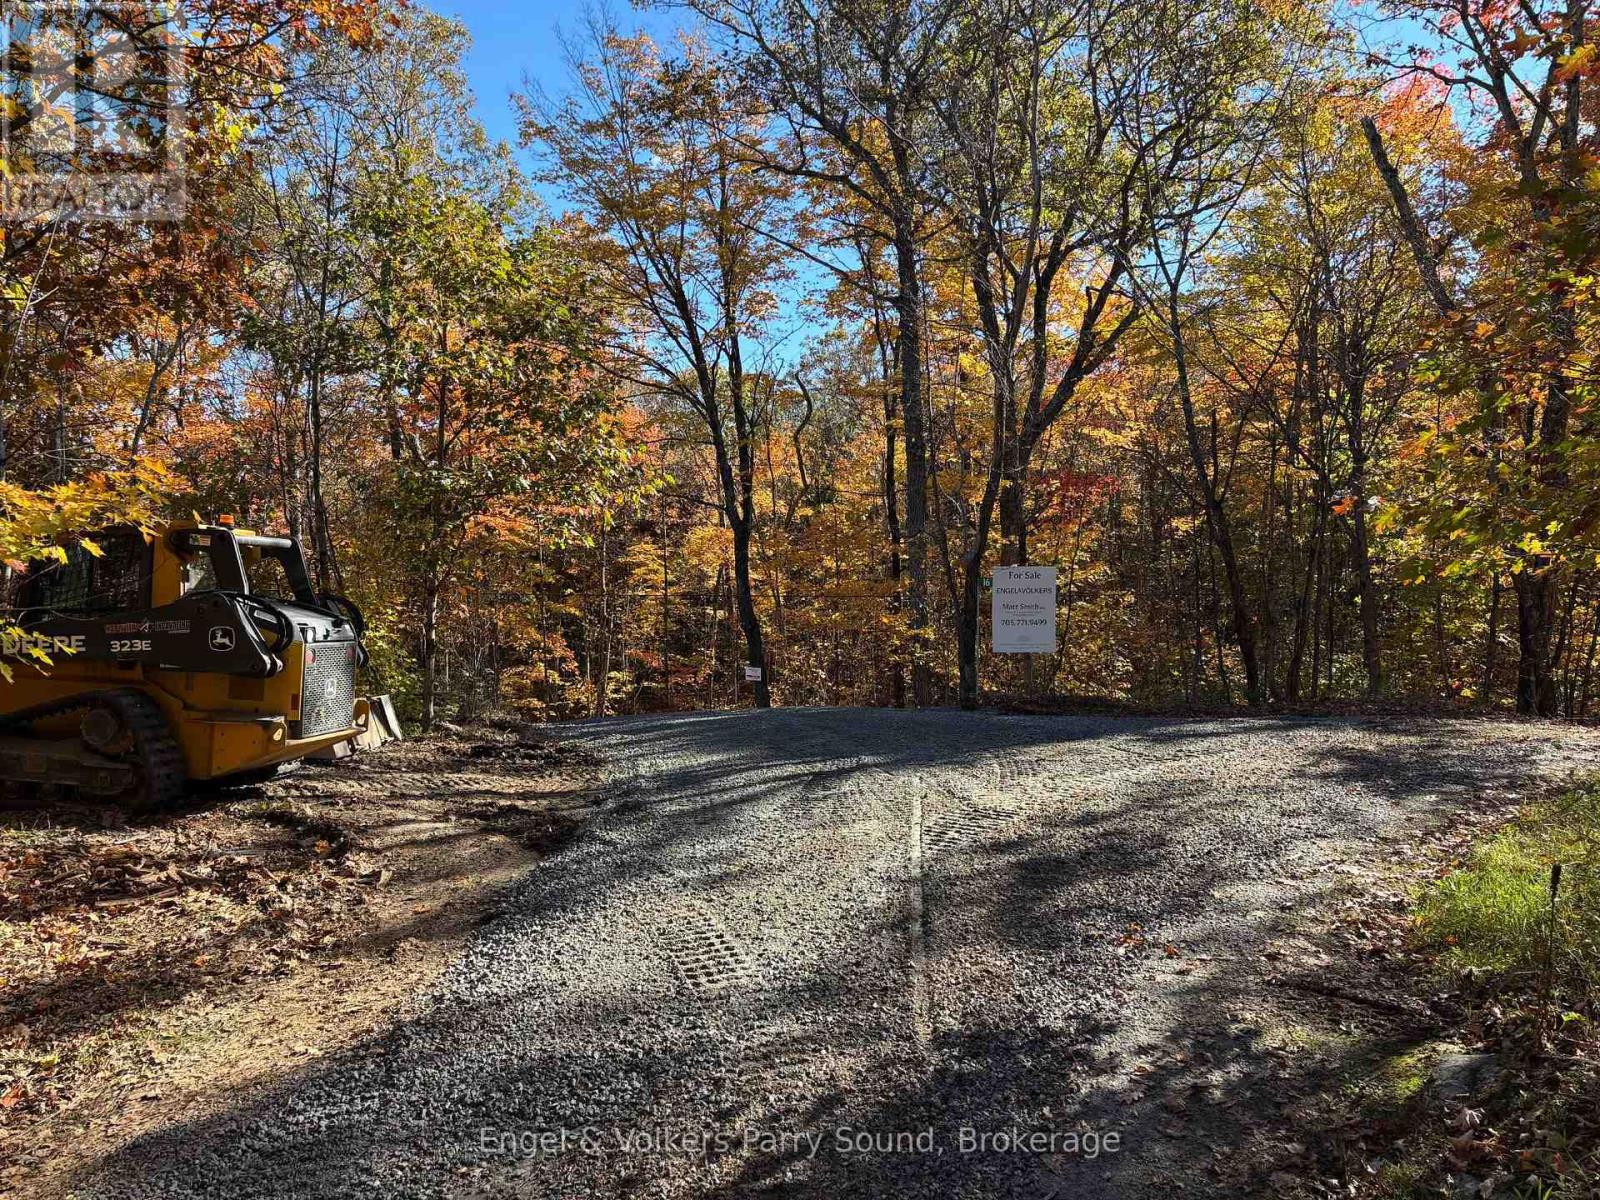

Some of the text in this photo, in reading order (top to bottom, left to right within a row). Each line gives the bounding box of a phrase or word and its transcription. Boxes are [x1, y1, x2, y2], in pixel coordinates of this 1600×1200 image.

[1008, 571, 1042, 580] For Sale
[2, 635, 87, 655] DEERE
[110, 640, 152, 652] 323E
